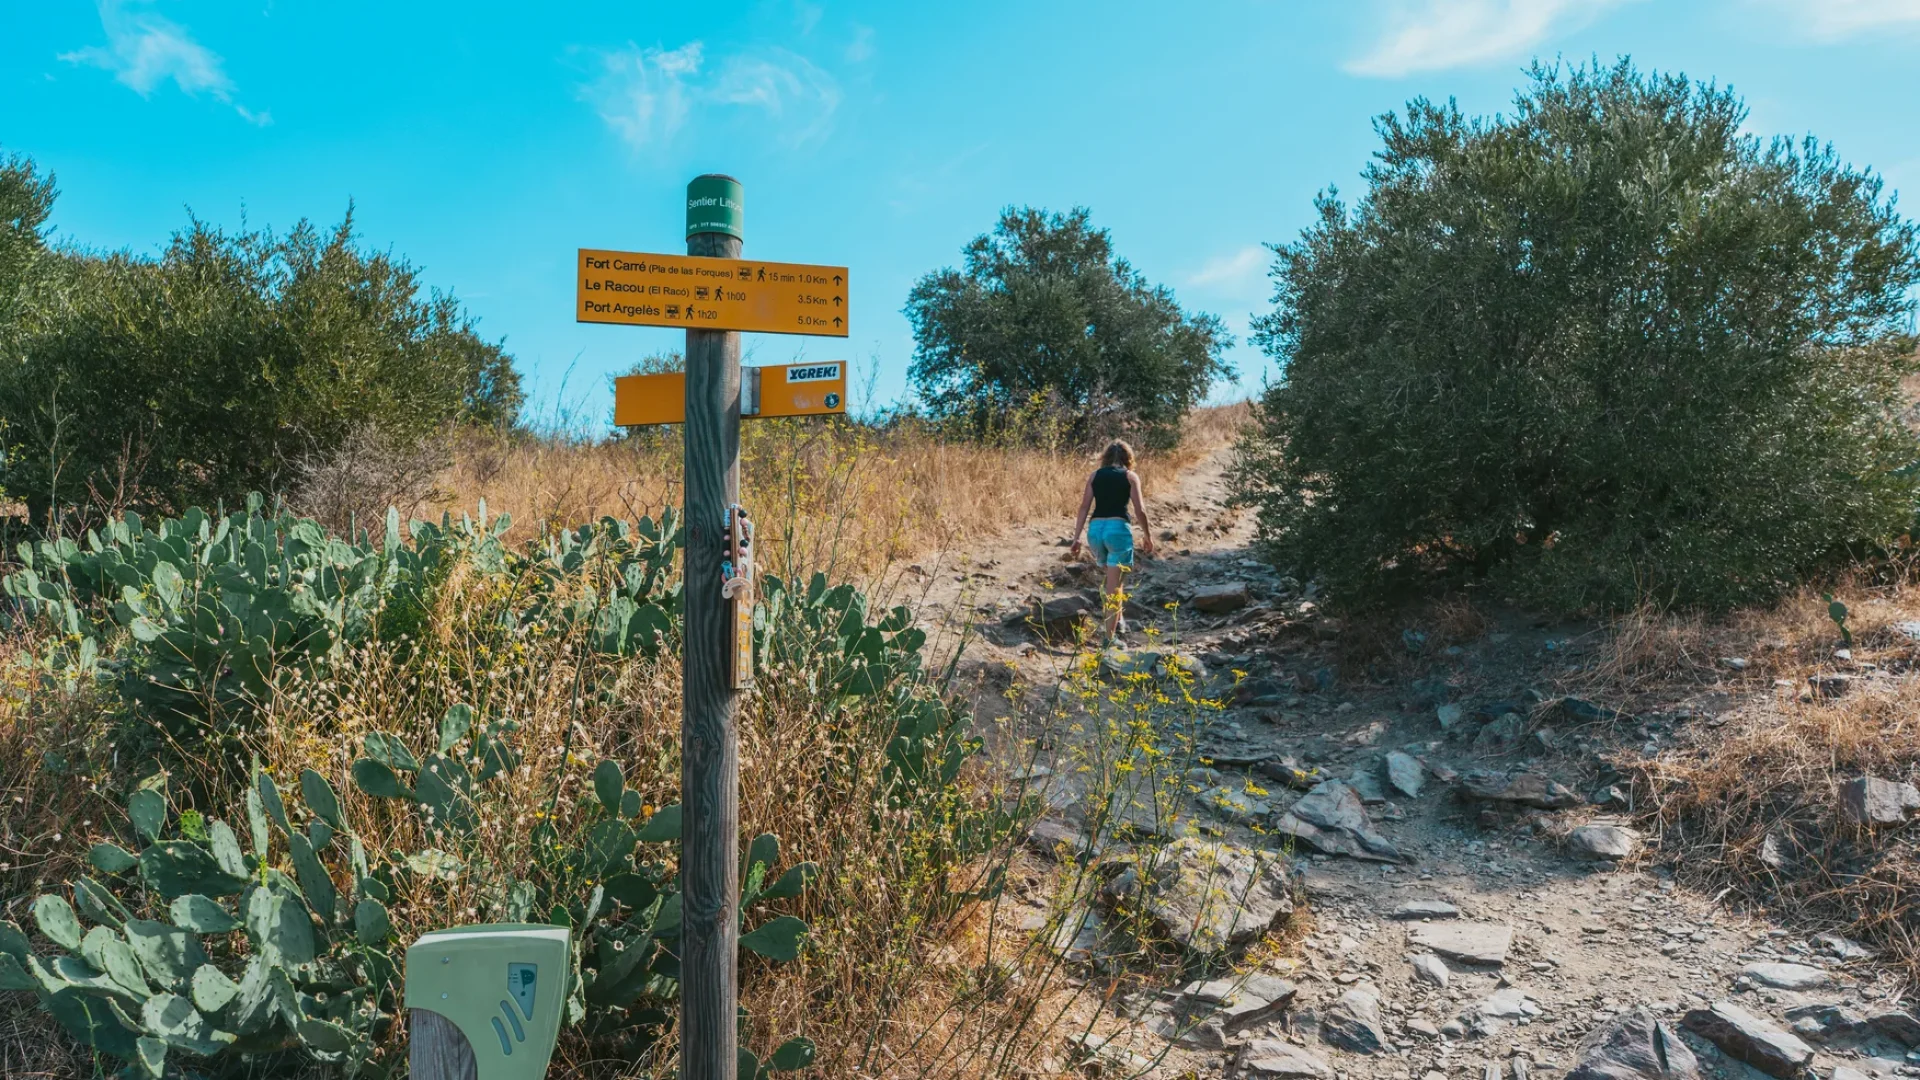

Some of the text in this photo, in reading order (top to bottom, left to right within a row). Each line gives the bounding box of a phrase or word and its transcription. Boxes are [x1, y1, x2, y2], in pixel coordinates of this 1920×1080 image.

[688, 196, 717, 210] Sentier
[585, 257, 610, 270] Fort
[613, 259, 646, 272] Carré
[648, 264, 666, 275] (Pla
[667, 265, 679, 275] de
[681, 266, 694, 276] las
[695, 267, 733, 280] Forques)
[768, 272, 779, 282] 15
[780, 273, 796, 283] min
[585, 279, 601, 291] Le
[604, 280, 645, 293] Racou
[648, 285, 661, 296] (El
[663, 286, 690, 298] Racó)
[726, 291, 746, 301] 1h00
[584, 301, 611, 313] Port
[613, 303, 660, 317] Argelès
[697, 309, 718, 320] 1h20
